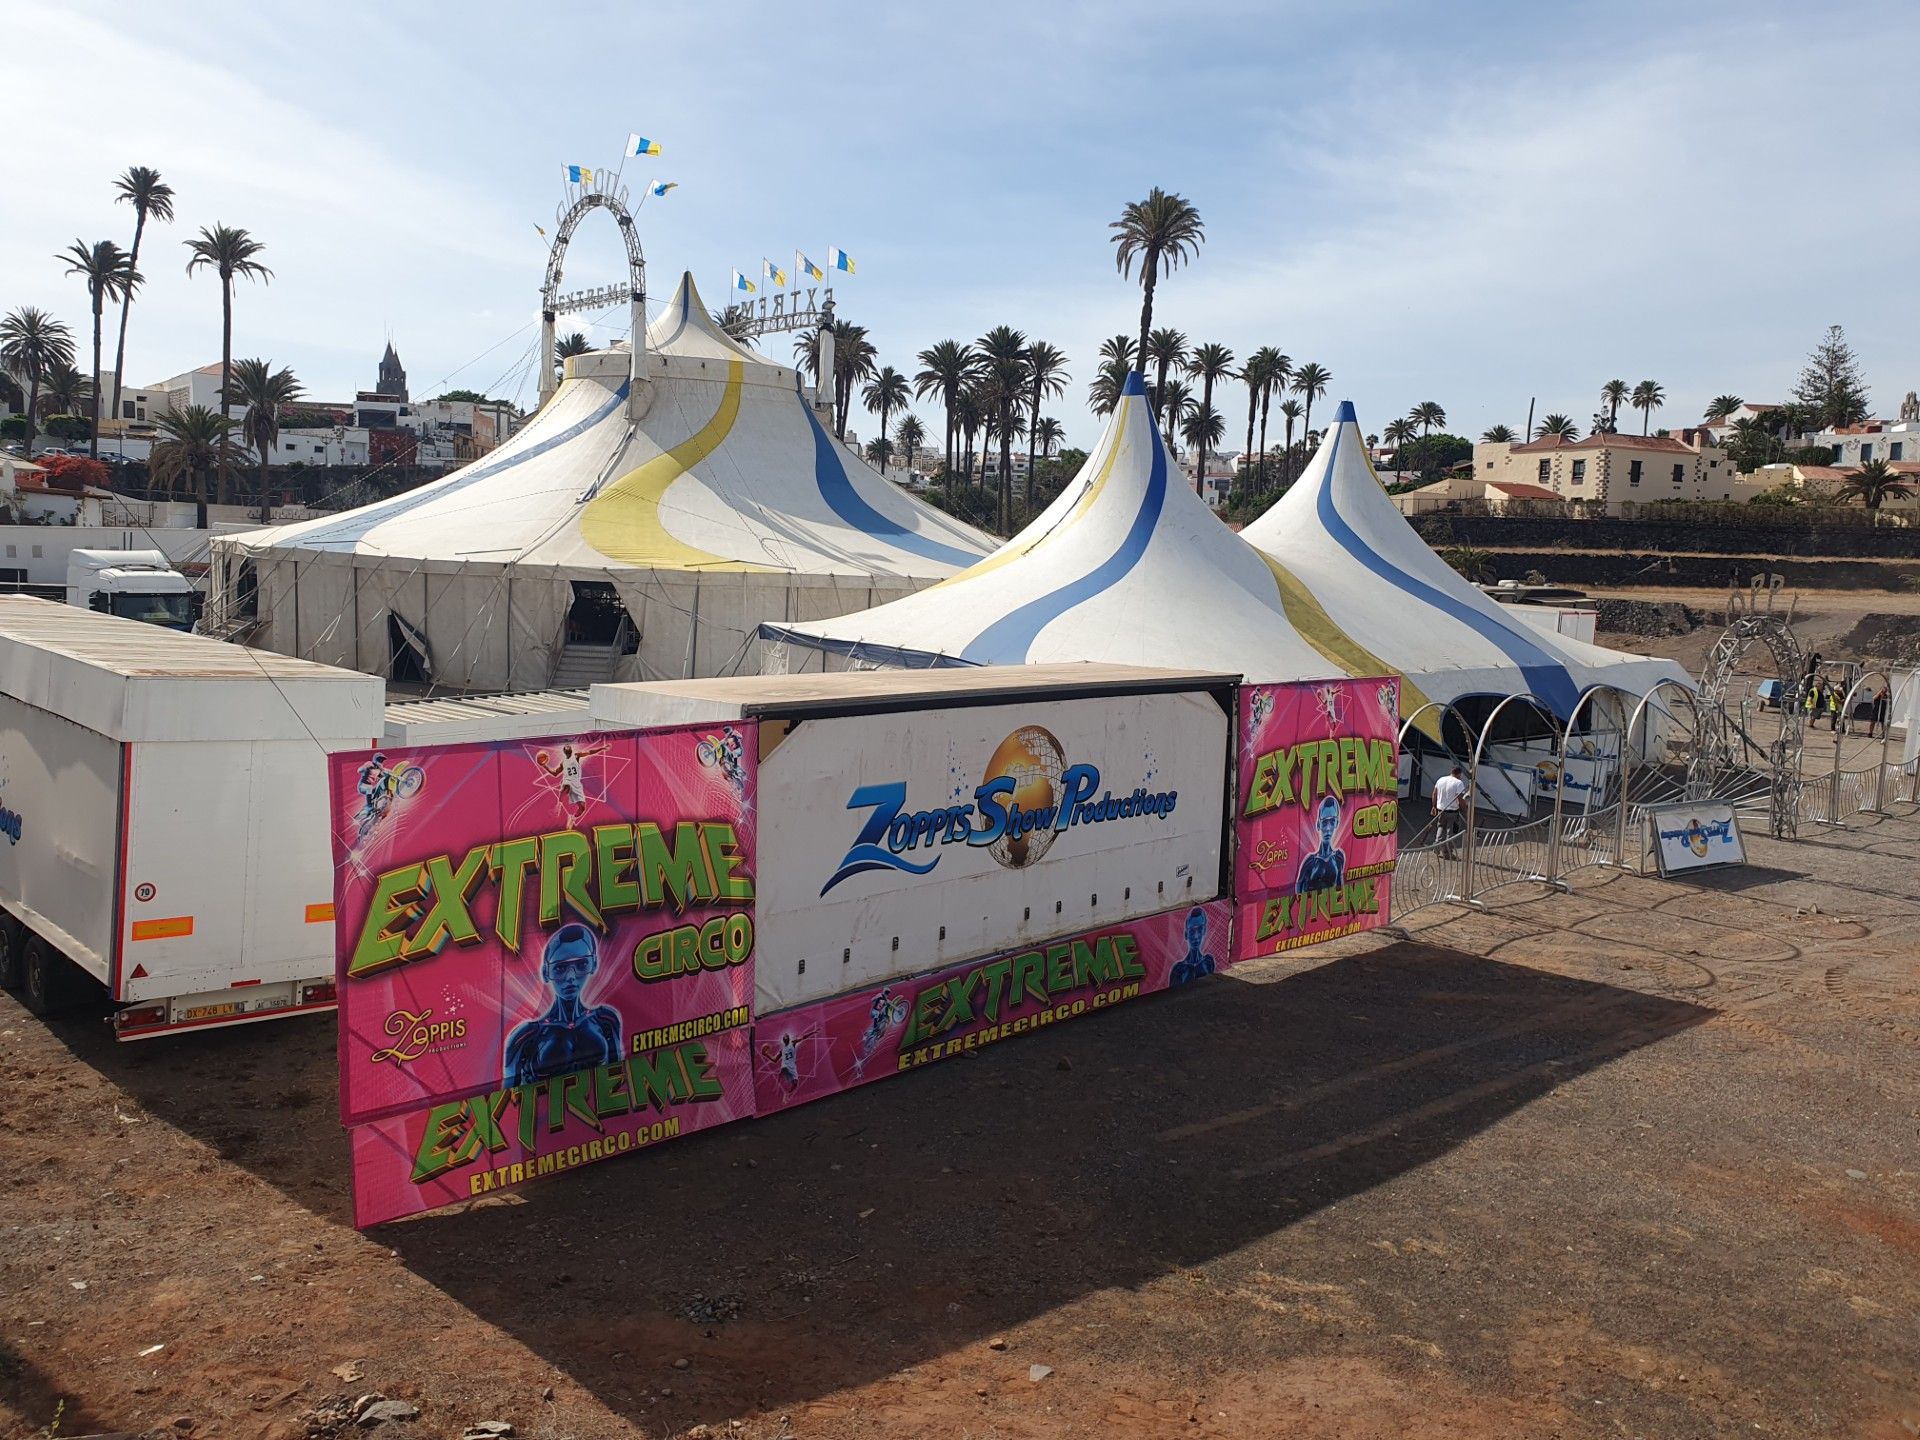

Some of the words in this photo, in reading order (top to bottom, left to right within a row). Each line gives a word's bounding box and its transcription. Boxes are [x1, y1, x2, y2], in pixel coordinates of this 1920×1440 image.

[557, 281, 628, 316] EXTREME
[567, 766, 578, 776] 23
[966, 775, 1059, 847] Show
[1054, 763, 1178, 832] Productions
[1244, 737, 1398, 818] EXTREME
[1352, 801, 1397, 838] CIRCO
[140, 888, 151, 897] 70
[347, 821, 757, 980] EXTREME
[1255, 878, 1380, 943] EXTREME
[633, 912, 754, 983] CIRCO
[1275, 921, 1361, 952] EXTREMECIRCO.COM
[897, 982, 1141, 1071] EXTREMECIRCO.COM
[900, 933, 1147, 1052] EXTREME
[632, 1005, 750, 1053] EXTREMECIRCO.COM
[409, 1043, 726, 1184] EXTREME
[469, 1116, 681, 1196] EXTREMECIRCO.COM
